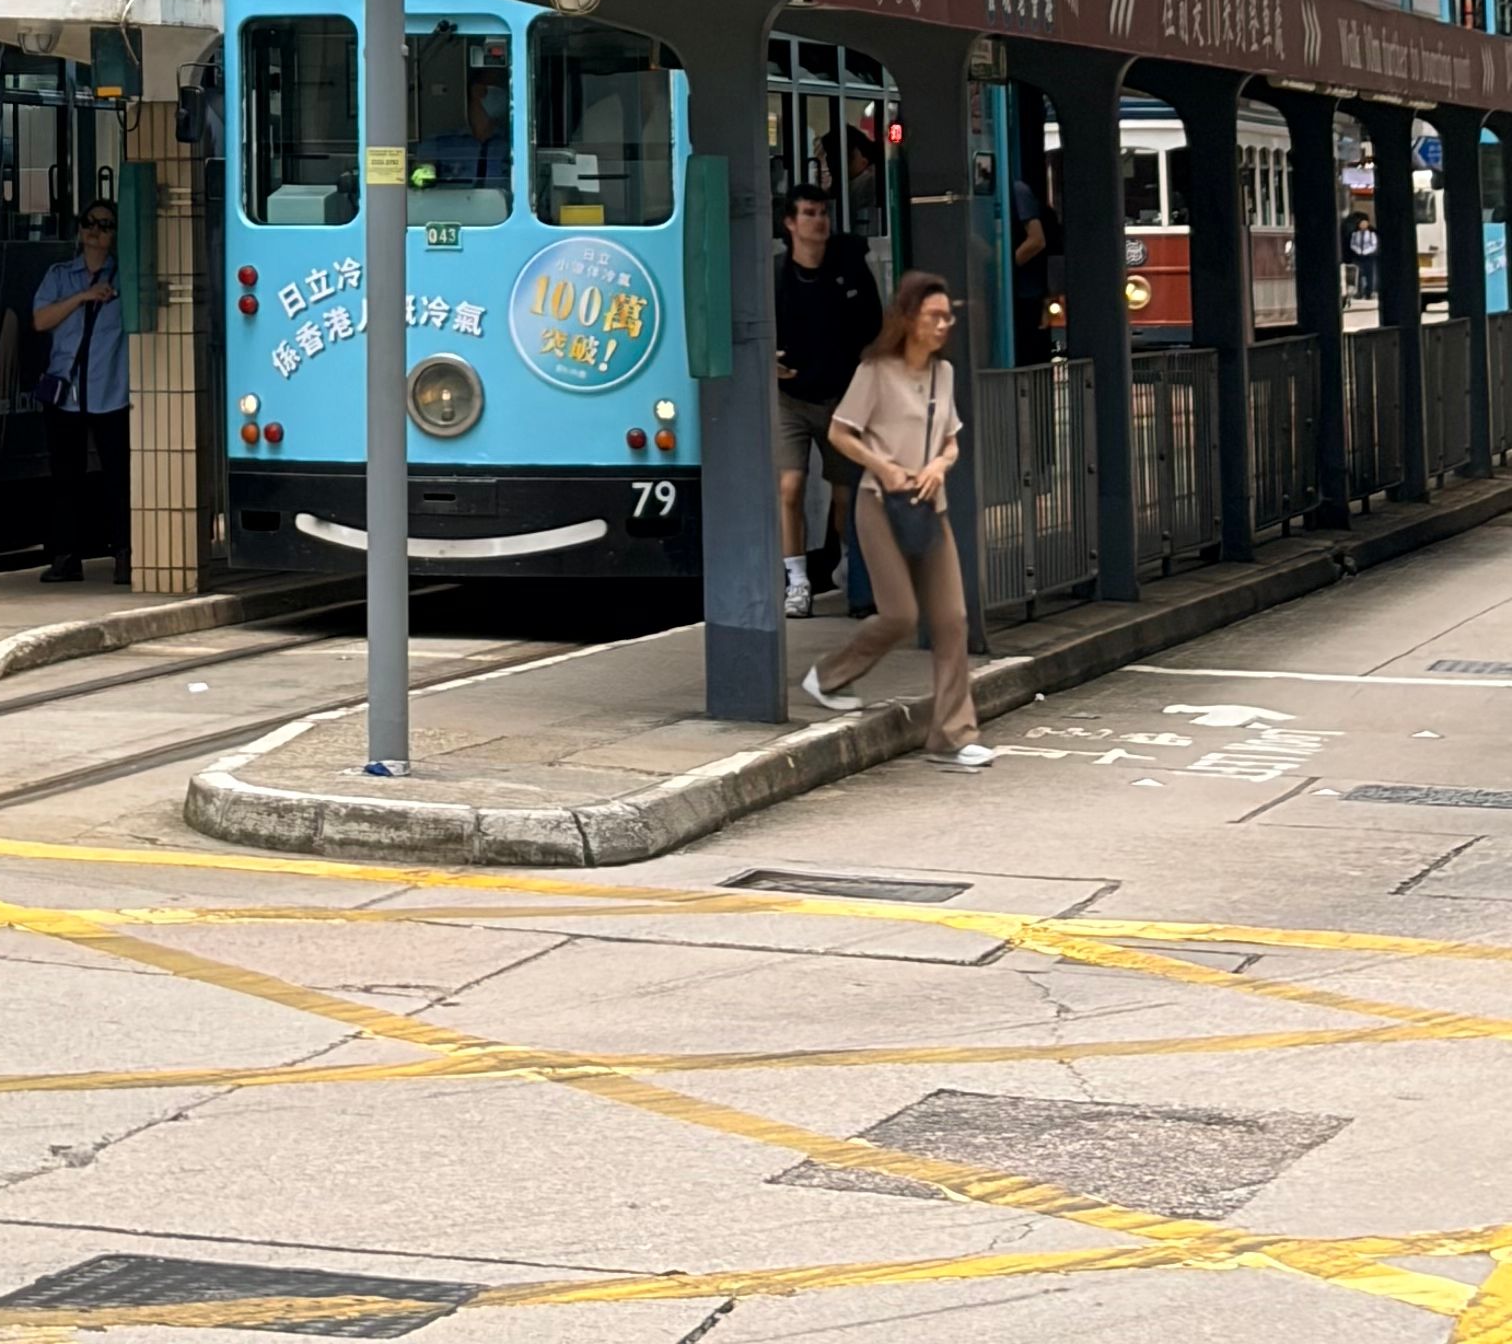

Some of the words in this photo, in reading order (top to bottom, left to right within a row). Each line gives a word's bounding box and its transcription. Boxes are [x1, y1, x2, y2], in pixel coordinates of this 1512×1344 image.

[427, 227, 457, 244] 043
[531, 274, 648, 339] 100萬
[631, 481, 677, 518] 79
